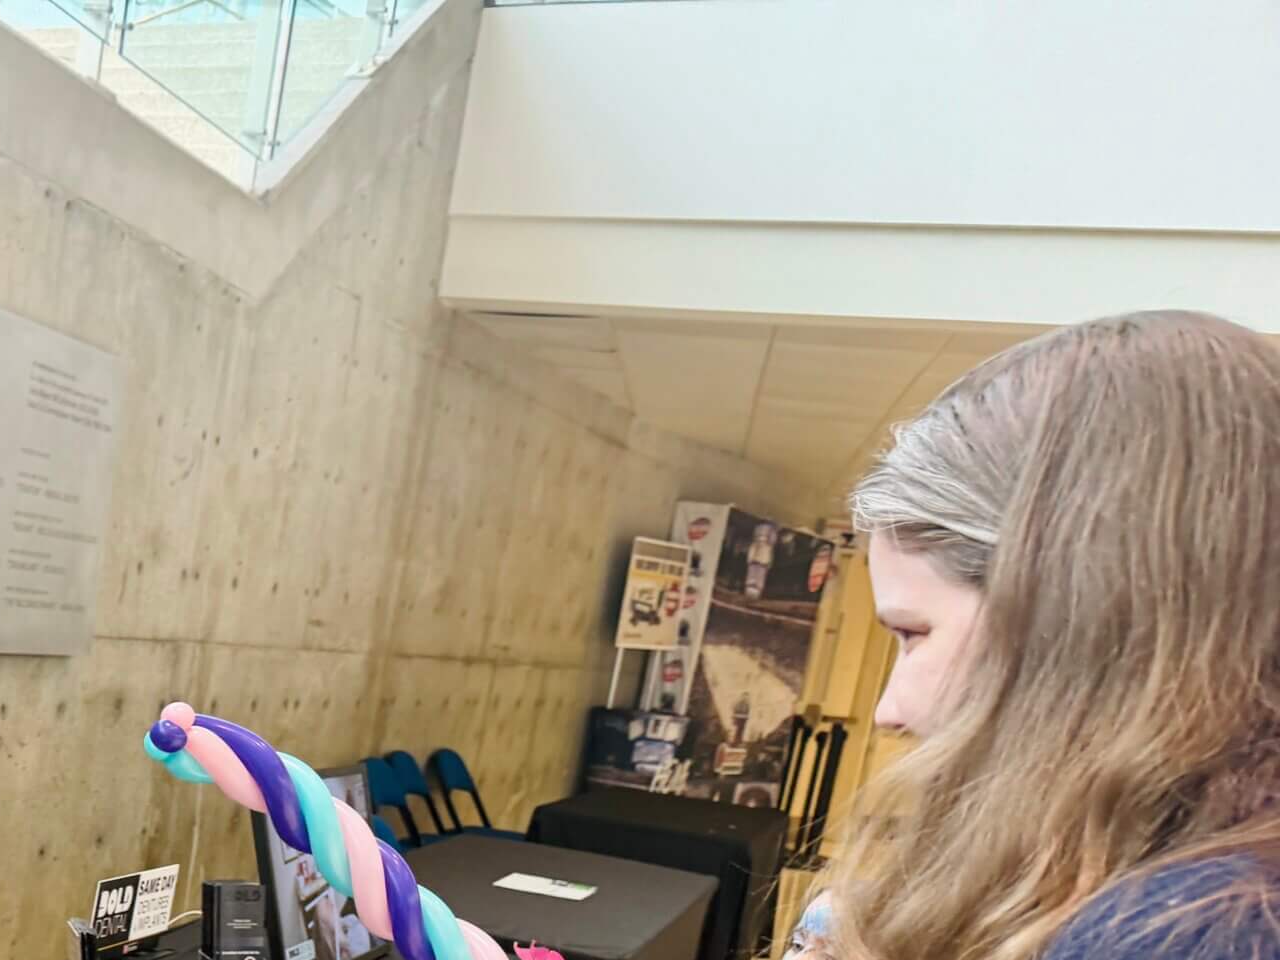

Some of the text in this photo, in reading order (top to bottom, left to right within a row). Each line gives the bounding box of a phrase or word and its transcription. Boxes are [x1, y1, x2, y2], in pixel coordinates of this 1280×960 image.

[138, 873, 177, 896] SAME DAY
[96, 884, 134, 919] BOLD
[94, 913, 129, 940] DENTAL
